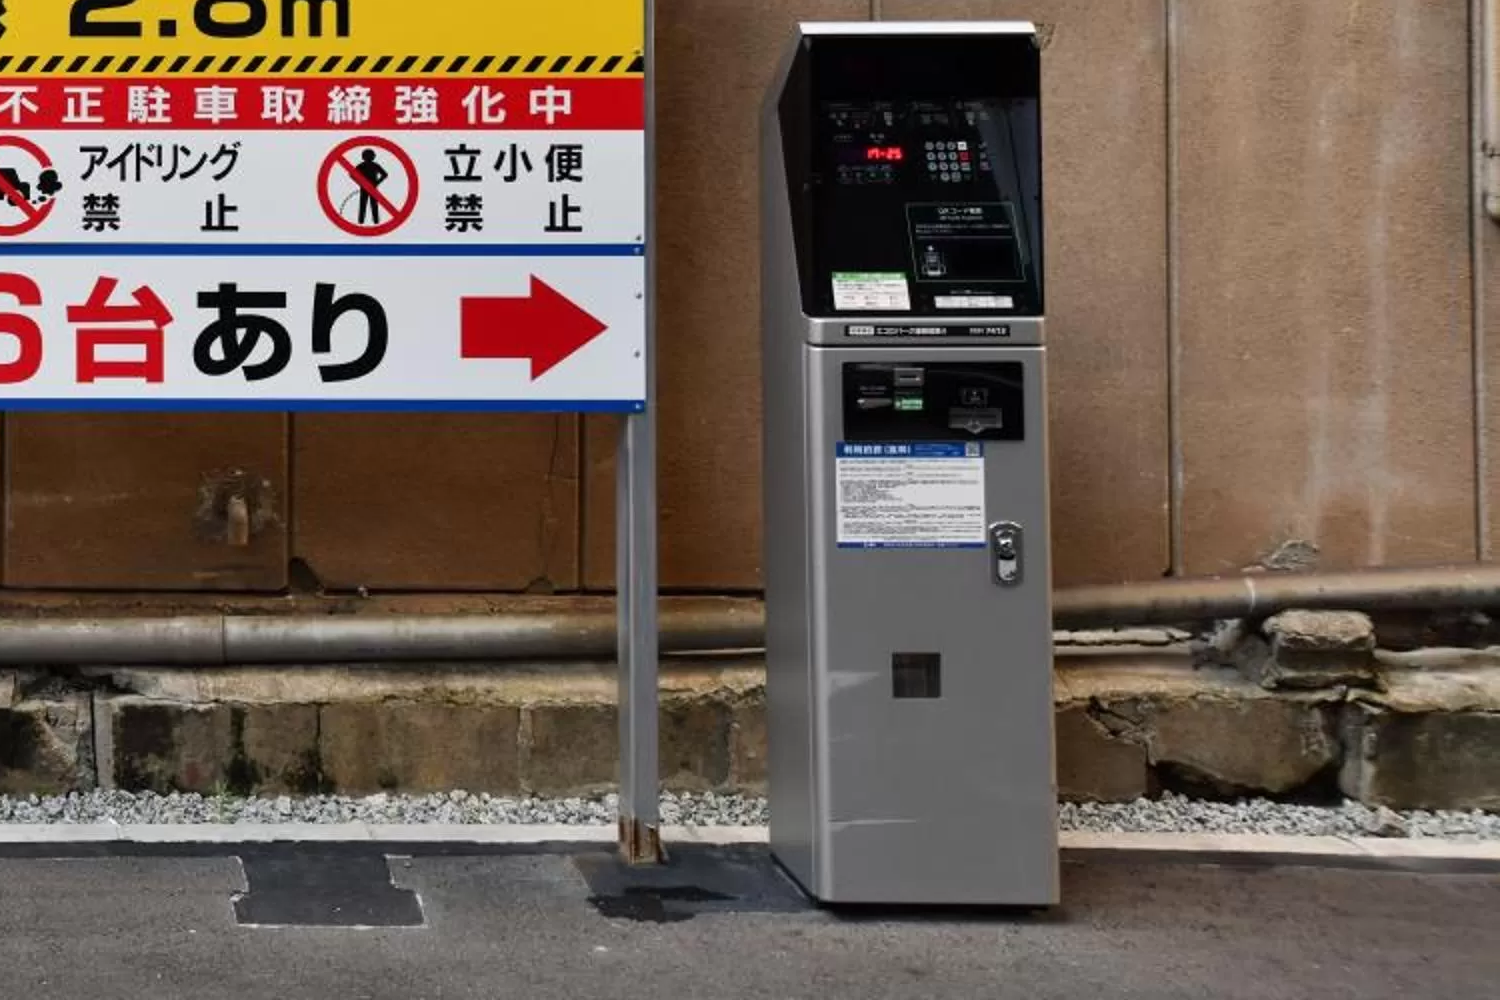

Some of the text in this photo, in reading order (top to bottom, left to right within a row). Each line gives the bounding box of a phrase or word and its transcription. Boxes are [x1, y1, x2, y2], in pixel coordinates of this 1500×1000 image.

[80, 142, 240, 182] アイドリング
[444, 144, 582, 182] 立小便
